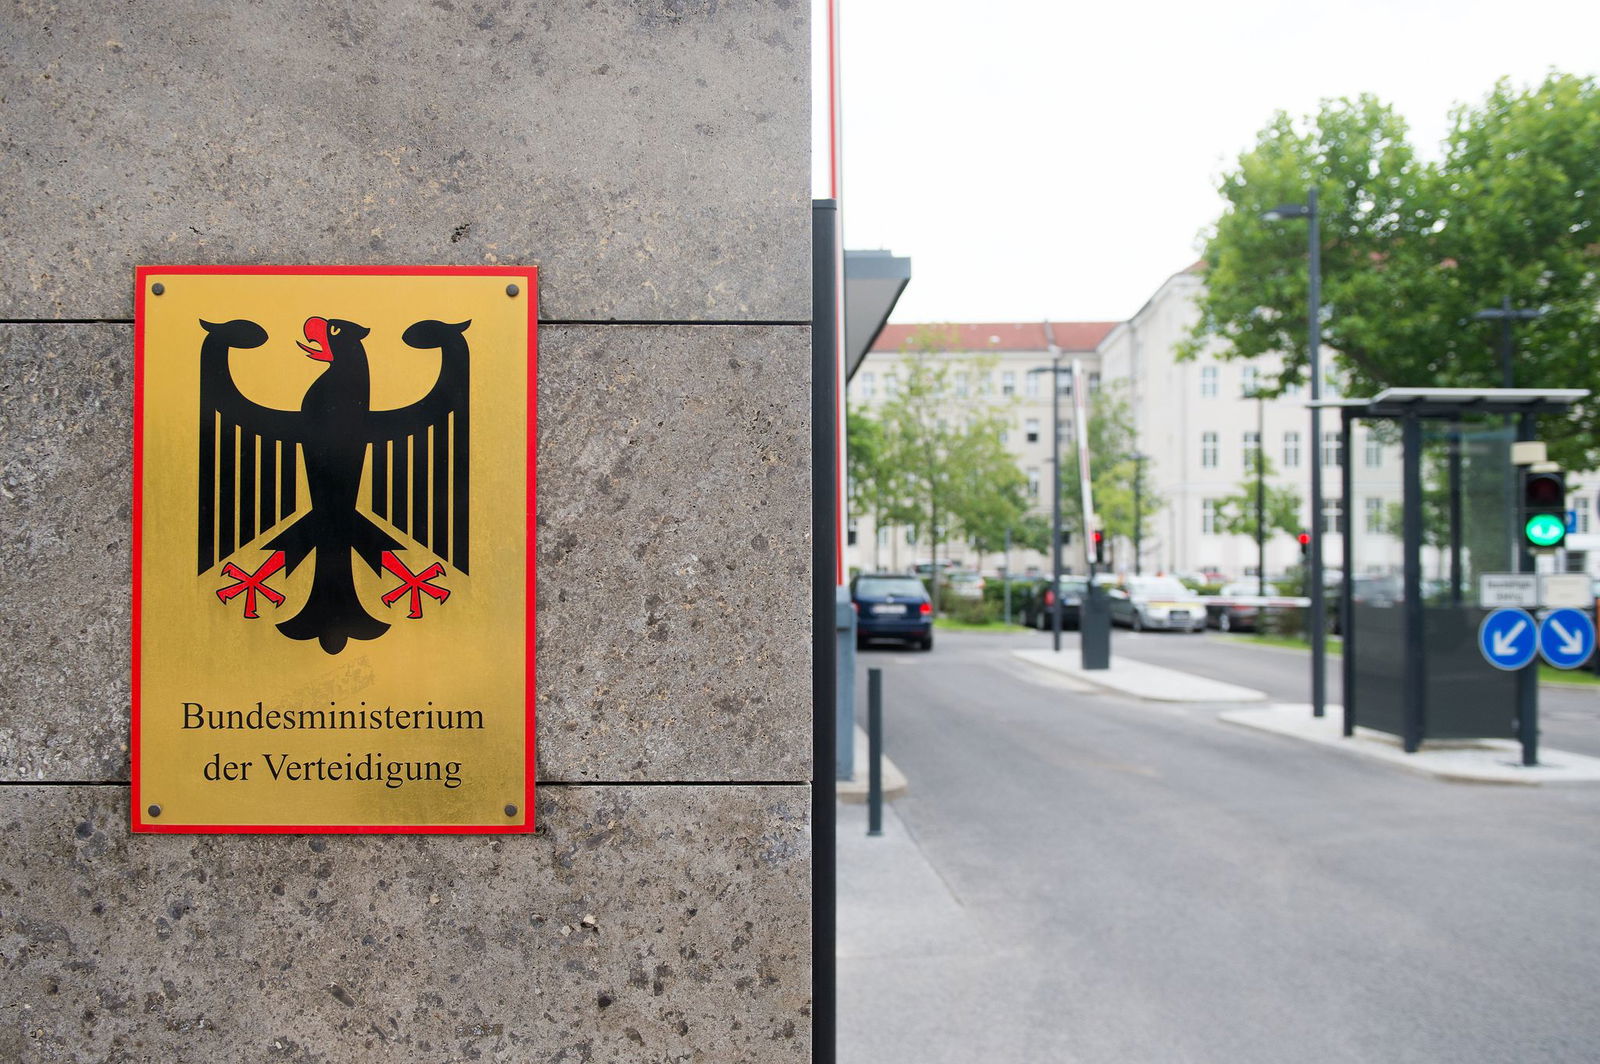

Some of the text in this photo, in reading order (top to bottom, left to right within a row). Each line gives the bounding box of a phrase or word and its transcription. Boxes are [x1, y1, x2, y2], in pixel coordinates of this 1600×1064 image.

[181, 701, 484, 730] Bundesministerium
[203, 752, 462, 789] der Verteidigung
